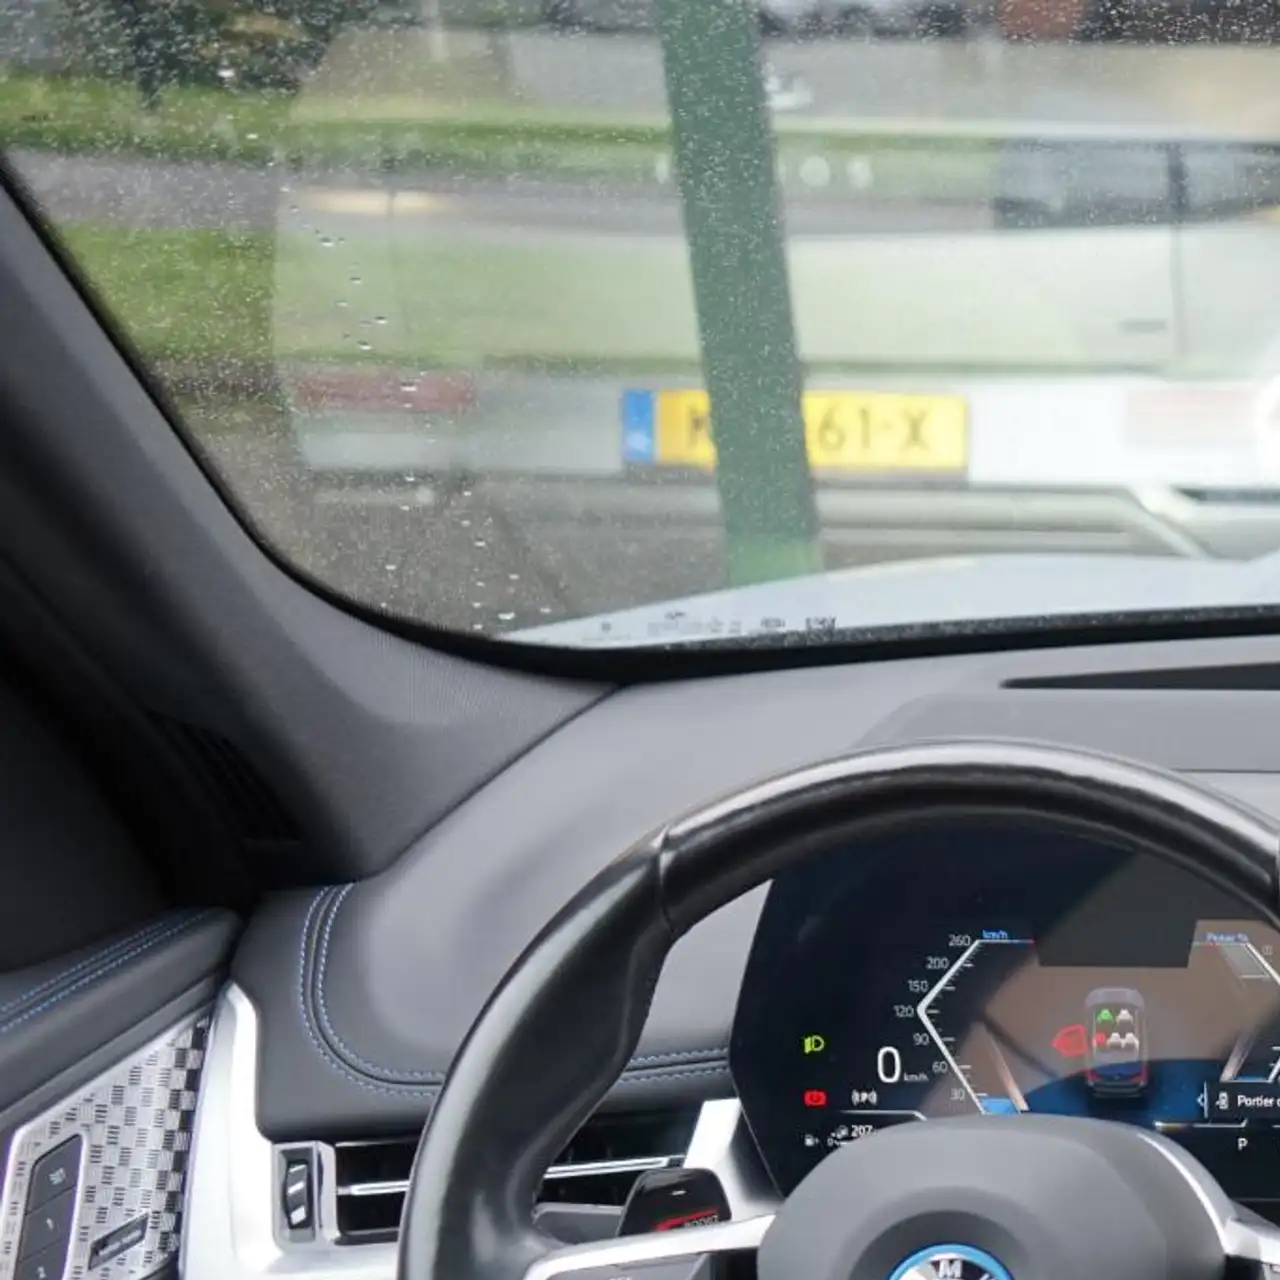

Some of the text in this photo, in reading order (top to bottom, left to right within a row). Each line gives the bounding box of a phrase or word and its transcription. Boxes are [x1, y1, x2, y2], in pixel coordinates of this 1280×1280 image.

[948, 934, 971, 947] 260
[926, 956, 949, 970] 200
[908, 980, 928, 992] 150
[893, 1005, 914, 1018] 120
[913, 1032, 929, 1046] 90
[877, 1046, 902, 1083] 0
[932, 1060, 949, 1074] 60
[950, 1088, 966, 1101] 30
[1237, 1095, 1274, 1107] Portier
[1238, 1138, 1247, 1150] P
